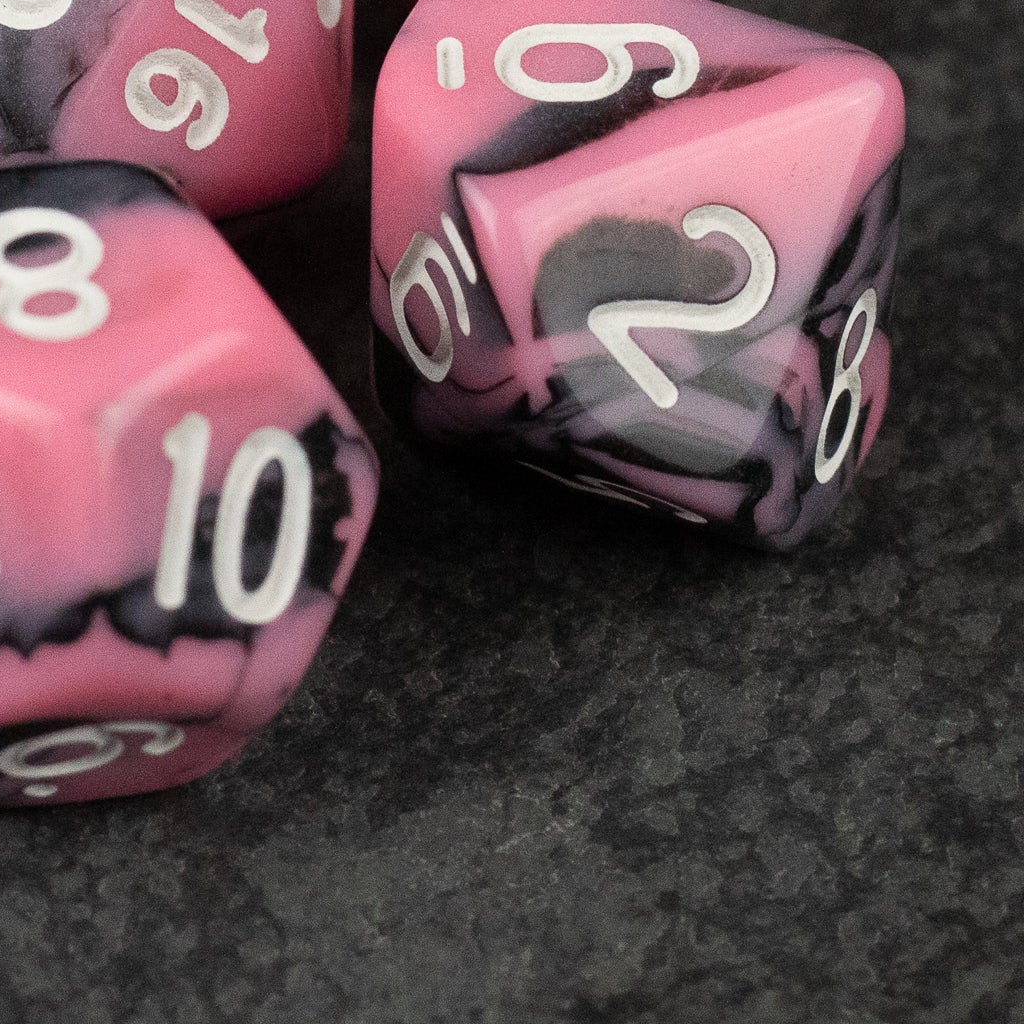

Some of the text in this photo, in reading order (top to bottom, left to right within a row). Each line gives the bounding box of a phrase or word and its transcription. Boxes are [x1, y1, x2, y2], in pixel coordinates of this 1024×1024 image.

[587, 204, 777, 409] 2
[814, 288, 877, 484] 8
[155, 412, 313, 625] 10
